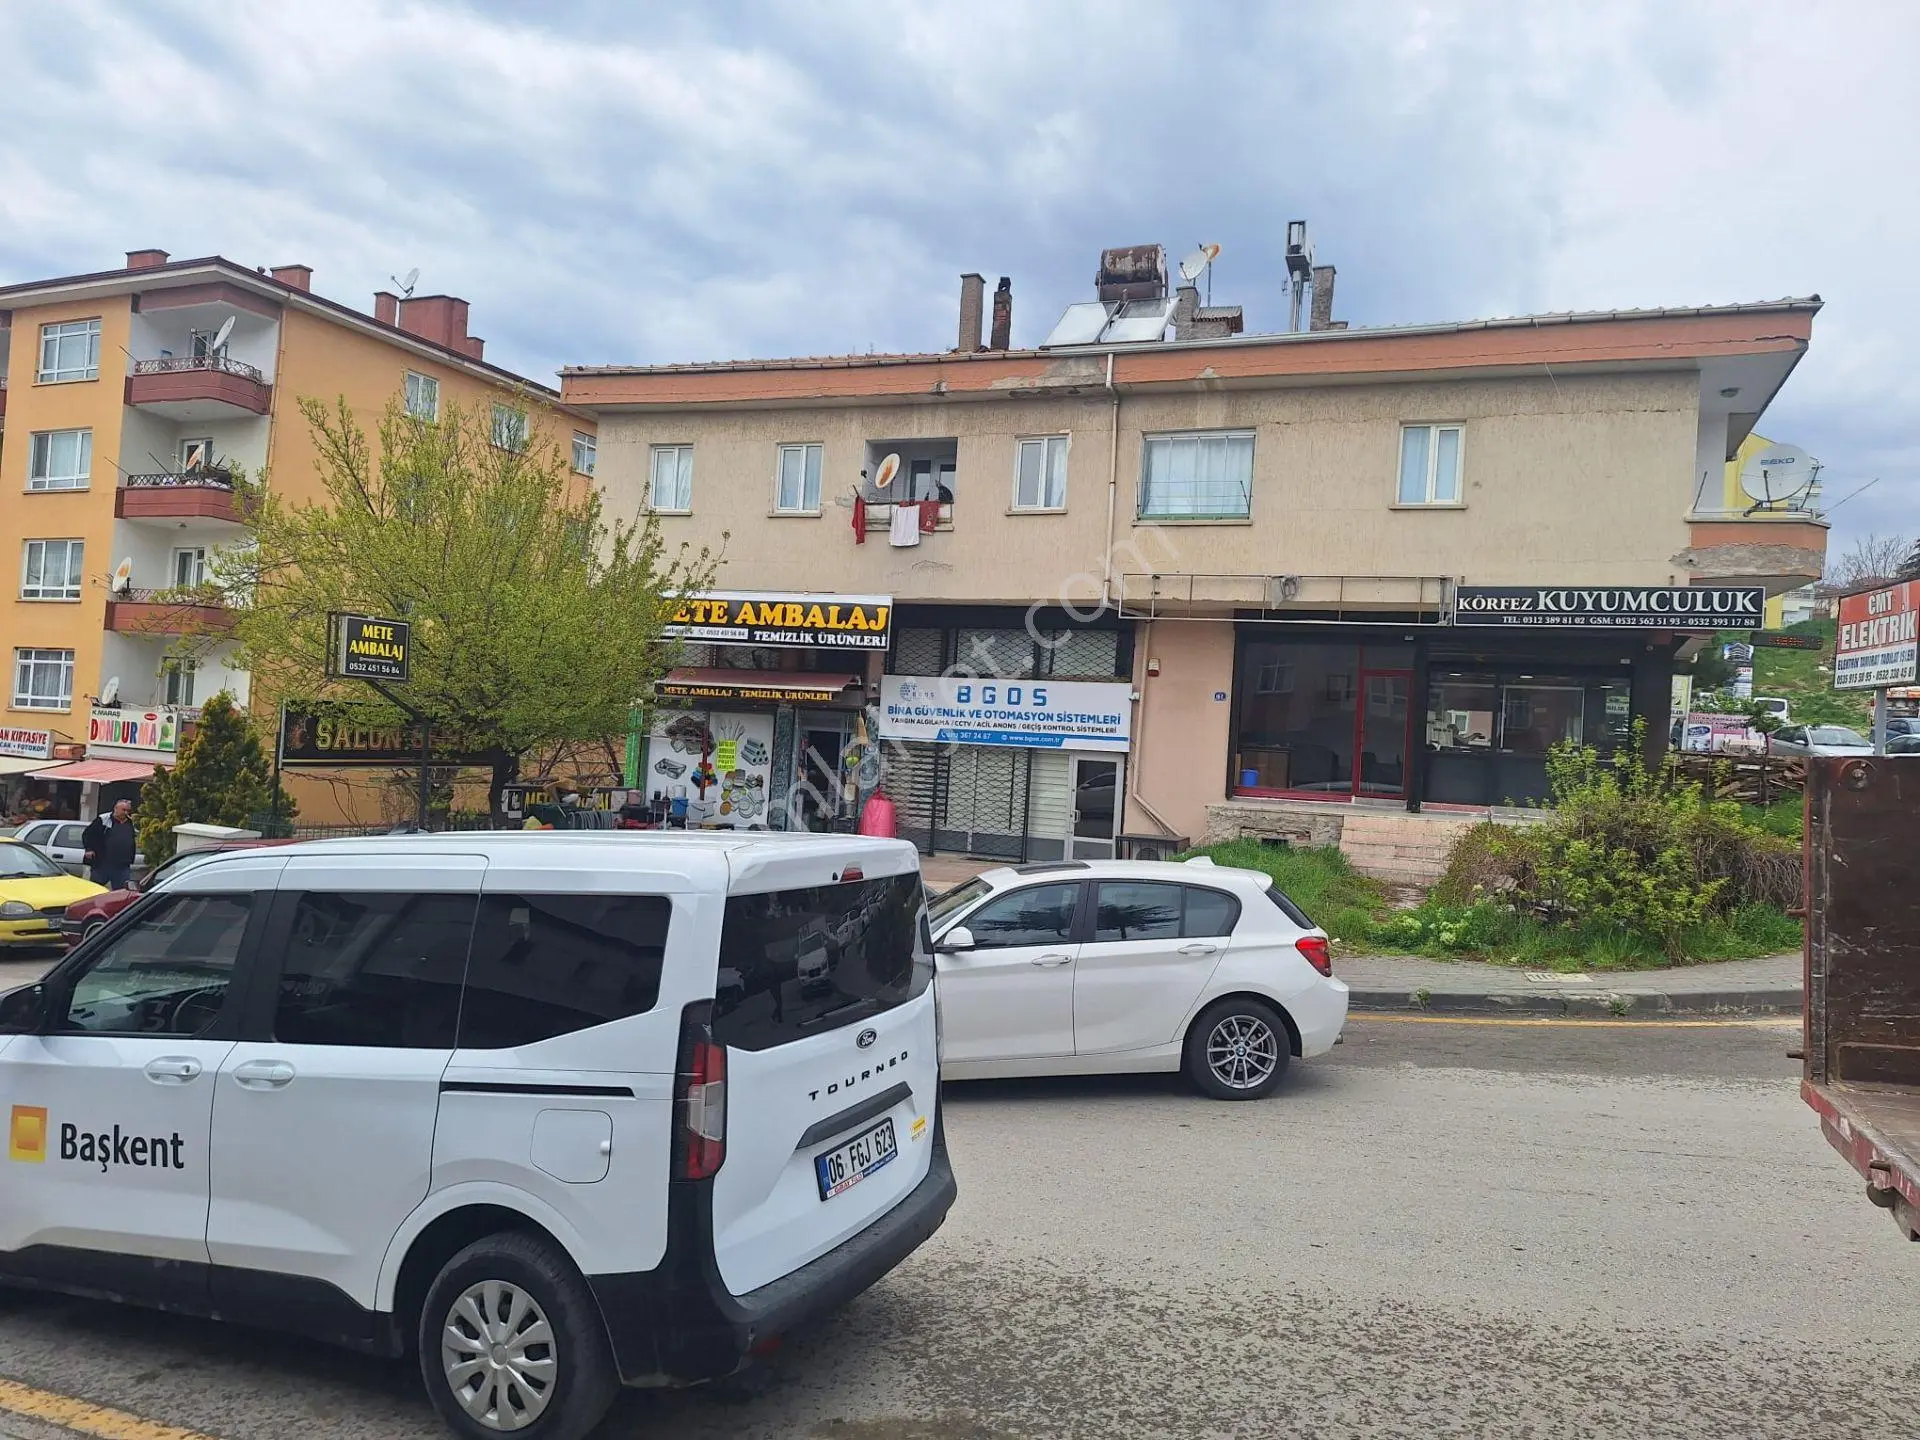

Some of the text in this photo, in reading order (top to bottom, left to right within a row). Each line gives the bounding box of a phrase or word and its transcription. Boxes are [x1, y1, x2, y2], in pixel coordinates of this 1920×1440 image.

[1458, 590, 1758, 613] KÖRFEZ KUYUMCULUK
[1869, 590, 1893, 615] CMT
[653, 600, 888, 631] ETE AMBALAJ
[362, 624, 394, 640] METE
[754, 629, 813, 644] TEMİZLİK
[818, 631, 886, 647] ÜRÜNLERİ
[350, 639, 403, 661] AMBALAJ
[349, 662, 367, 672] 0532
[368, 664, 380, 672] 451
[382, 665, 390, 673] 56
[664, 686, 687, 695] METE
[690, 688, 732, 697] AMBALAJ
[739, 689, 782, 699] TEMİZLİK
[785, 690, 832, 700] ÜRÜNLERİ
[957, 685, 1048, 706] BGOS
[888, 704, 1121, 725] BİNA GÜVENLİK VE OTOMASYON SİSTEMLERİ
[90, 718, 156, 746] DONDURMA
[1043, 724, 1075, 732] KONTROL
[808, 1051, 908, 1101] TOURNEO
[61, 1123, 184, 1172] Başkent
[828, 1154, 844, 1184] 06
[849, 1138, 871, 1172] FGJ
[874, 1125, 893, 1156] 623
